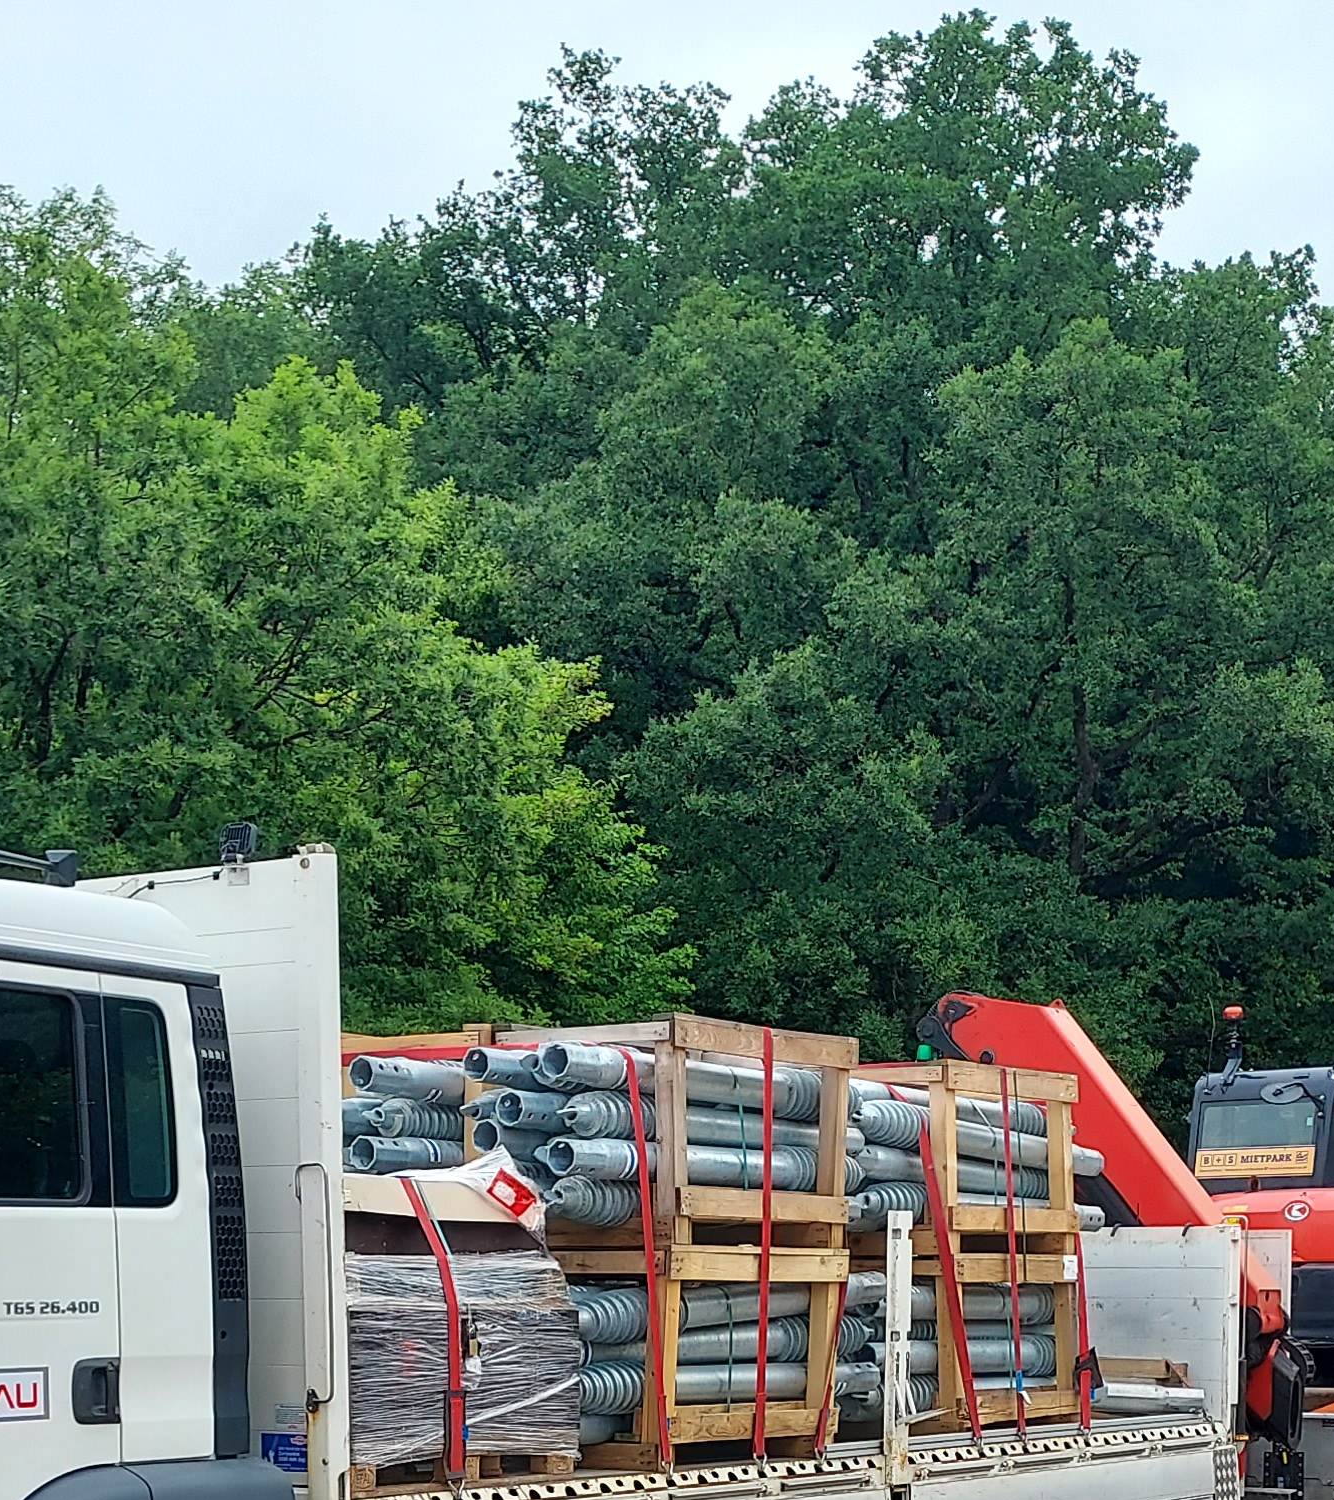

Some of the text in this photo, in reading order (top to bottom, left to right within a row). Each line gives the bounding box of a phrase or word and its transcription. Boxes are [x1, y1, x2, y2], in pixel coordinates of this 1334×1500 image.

[1240, 1153, 1292, 1164] MIETPARK
[3, 1301, 99, 1315] TGS 26.400
